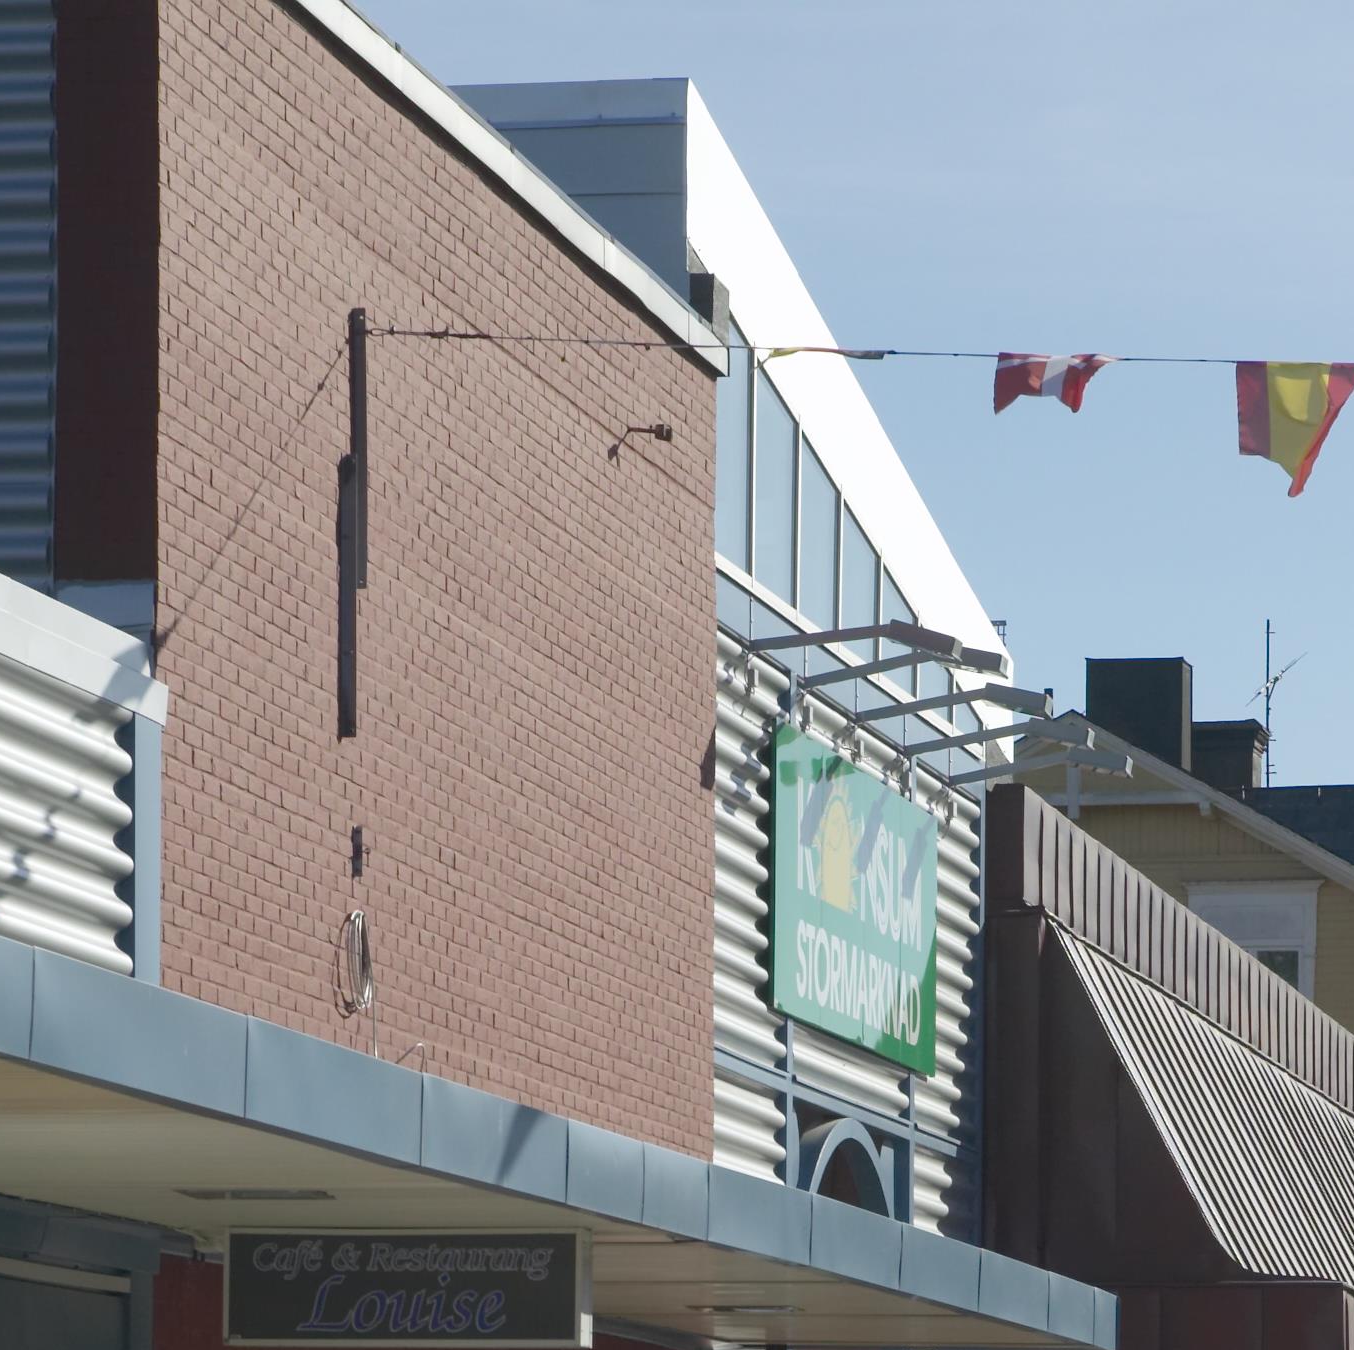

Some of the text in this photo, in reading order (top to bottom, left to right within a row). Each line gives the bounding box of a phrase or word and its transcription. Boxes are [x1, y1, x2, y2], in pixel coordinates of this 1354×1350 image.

[796, 919, 921, 1046] STORMARKNAD
[252, 1239, 554, 1281] Café & Restaurang
[295, 1272, 507, 1333] Louise
